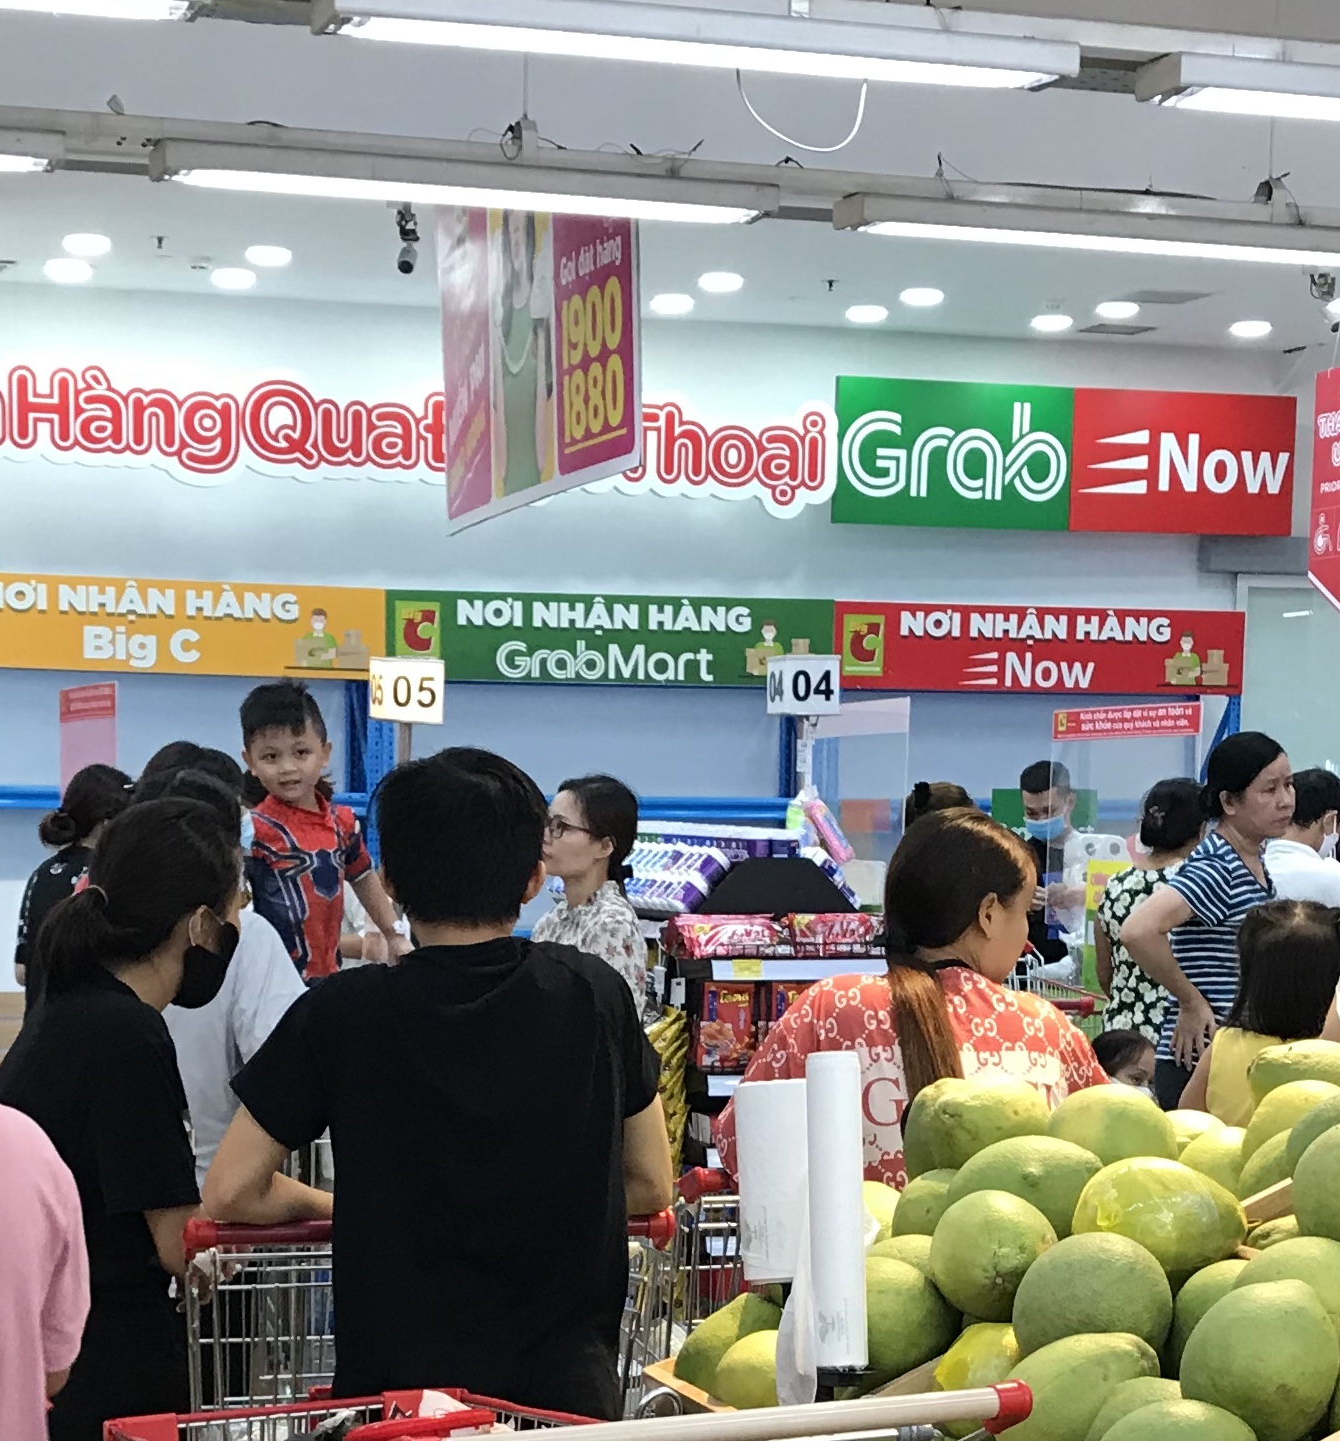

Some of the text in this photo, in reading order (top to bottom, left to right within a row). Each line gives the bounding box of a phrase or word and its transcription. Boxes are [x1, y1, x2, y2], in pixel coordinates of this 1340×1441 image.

[562, 276, 623, 370] 1900
[563, 353, 625, 443] 1880
[8, 366, 239, 474] Hàng
[841, 402, 1069, 502] Grab
[1157, 432, 1290, 495] Now
[58, 579, 176, 622] NHẬN
[186, 584, 299, 621] HÀNG
[456, 596, 752, 636] NƠI NHẬN HÀNG
[83, 625, 202, 668] Big C
[899, 608, 1172, 646] NƠI NHẬN HÀNG
[495, 639, 714, 682] GrabMart
[1003, 652, 1095, 690] Now
[392, 675, 436, 708] 05
[792, 669, 834, 702] 04
